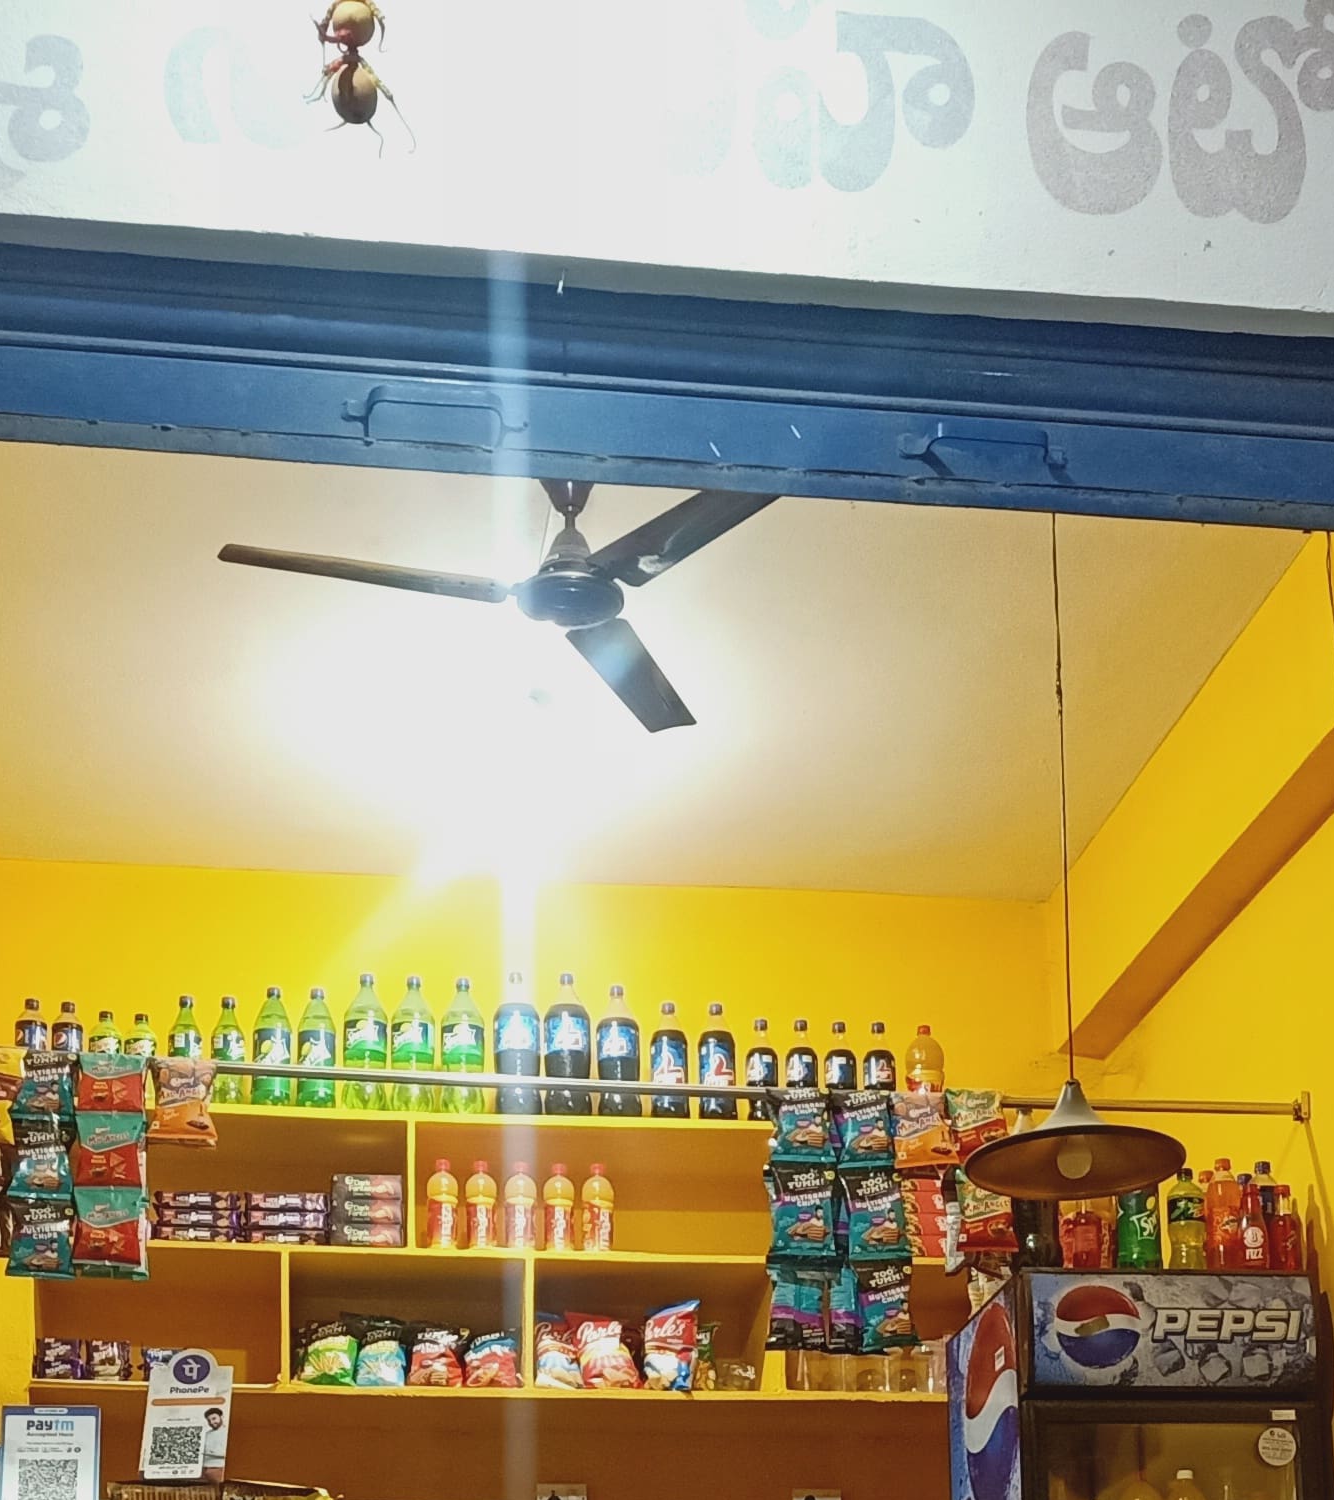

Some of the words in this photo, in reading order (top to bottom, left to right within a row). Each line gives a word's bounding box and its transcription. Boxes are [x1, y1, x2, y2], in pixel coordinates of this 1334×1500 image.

[792, 1172, 814, 1181] TOO
[861, 1176, 884, 1186] TOO
[787, 1179, 825, 1190] YUMM!
[856, 1181, 893, 1197] YUMM!
[872, 1268, 894, 1279] TOO
[869, 1273, 905, 1287] YUMM!
[1151, 1307, 1304, 1343] PEPSI
[169, 1386, 210, 1394] PhonePe
[26, 1419, 75, 1432] paytm
